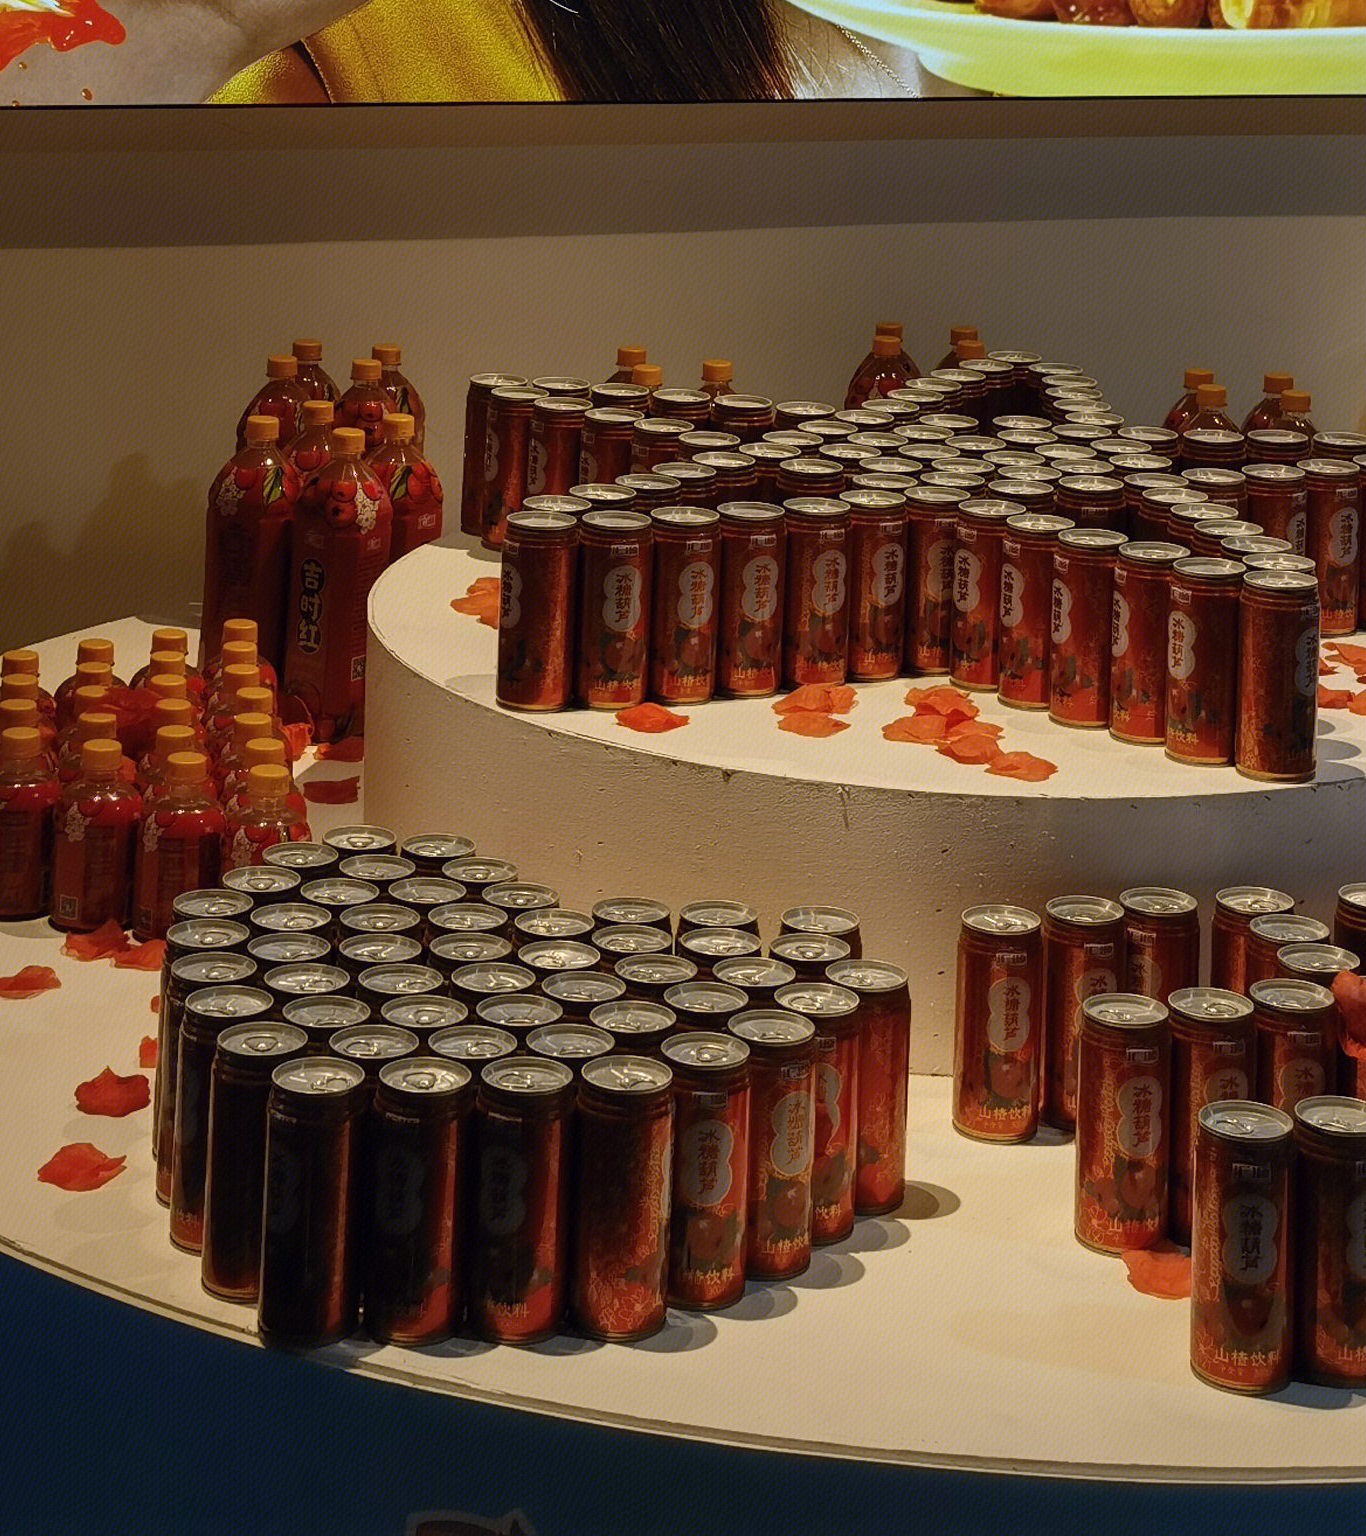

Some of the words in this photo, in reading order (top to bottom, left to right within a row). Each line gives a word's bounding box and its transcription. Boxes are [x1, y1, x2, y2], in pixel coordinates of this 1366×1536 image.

[1003, 983, 1021, 1041] 冰糖葫芦
[698, 1129, 721, 1195] 冰糖葫芦
